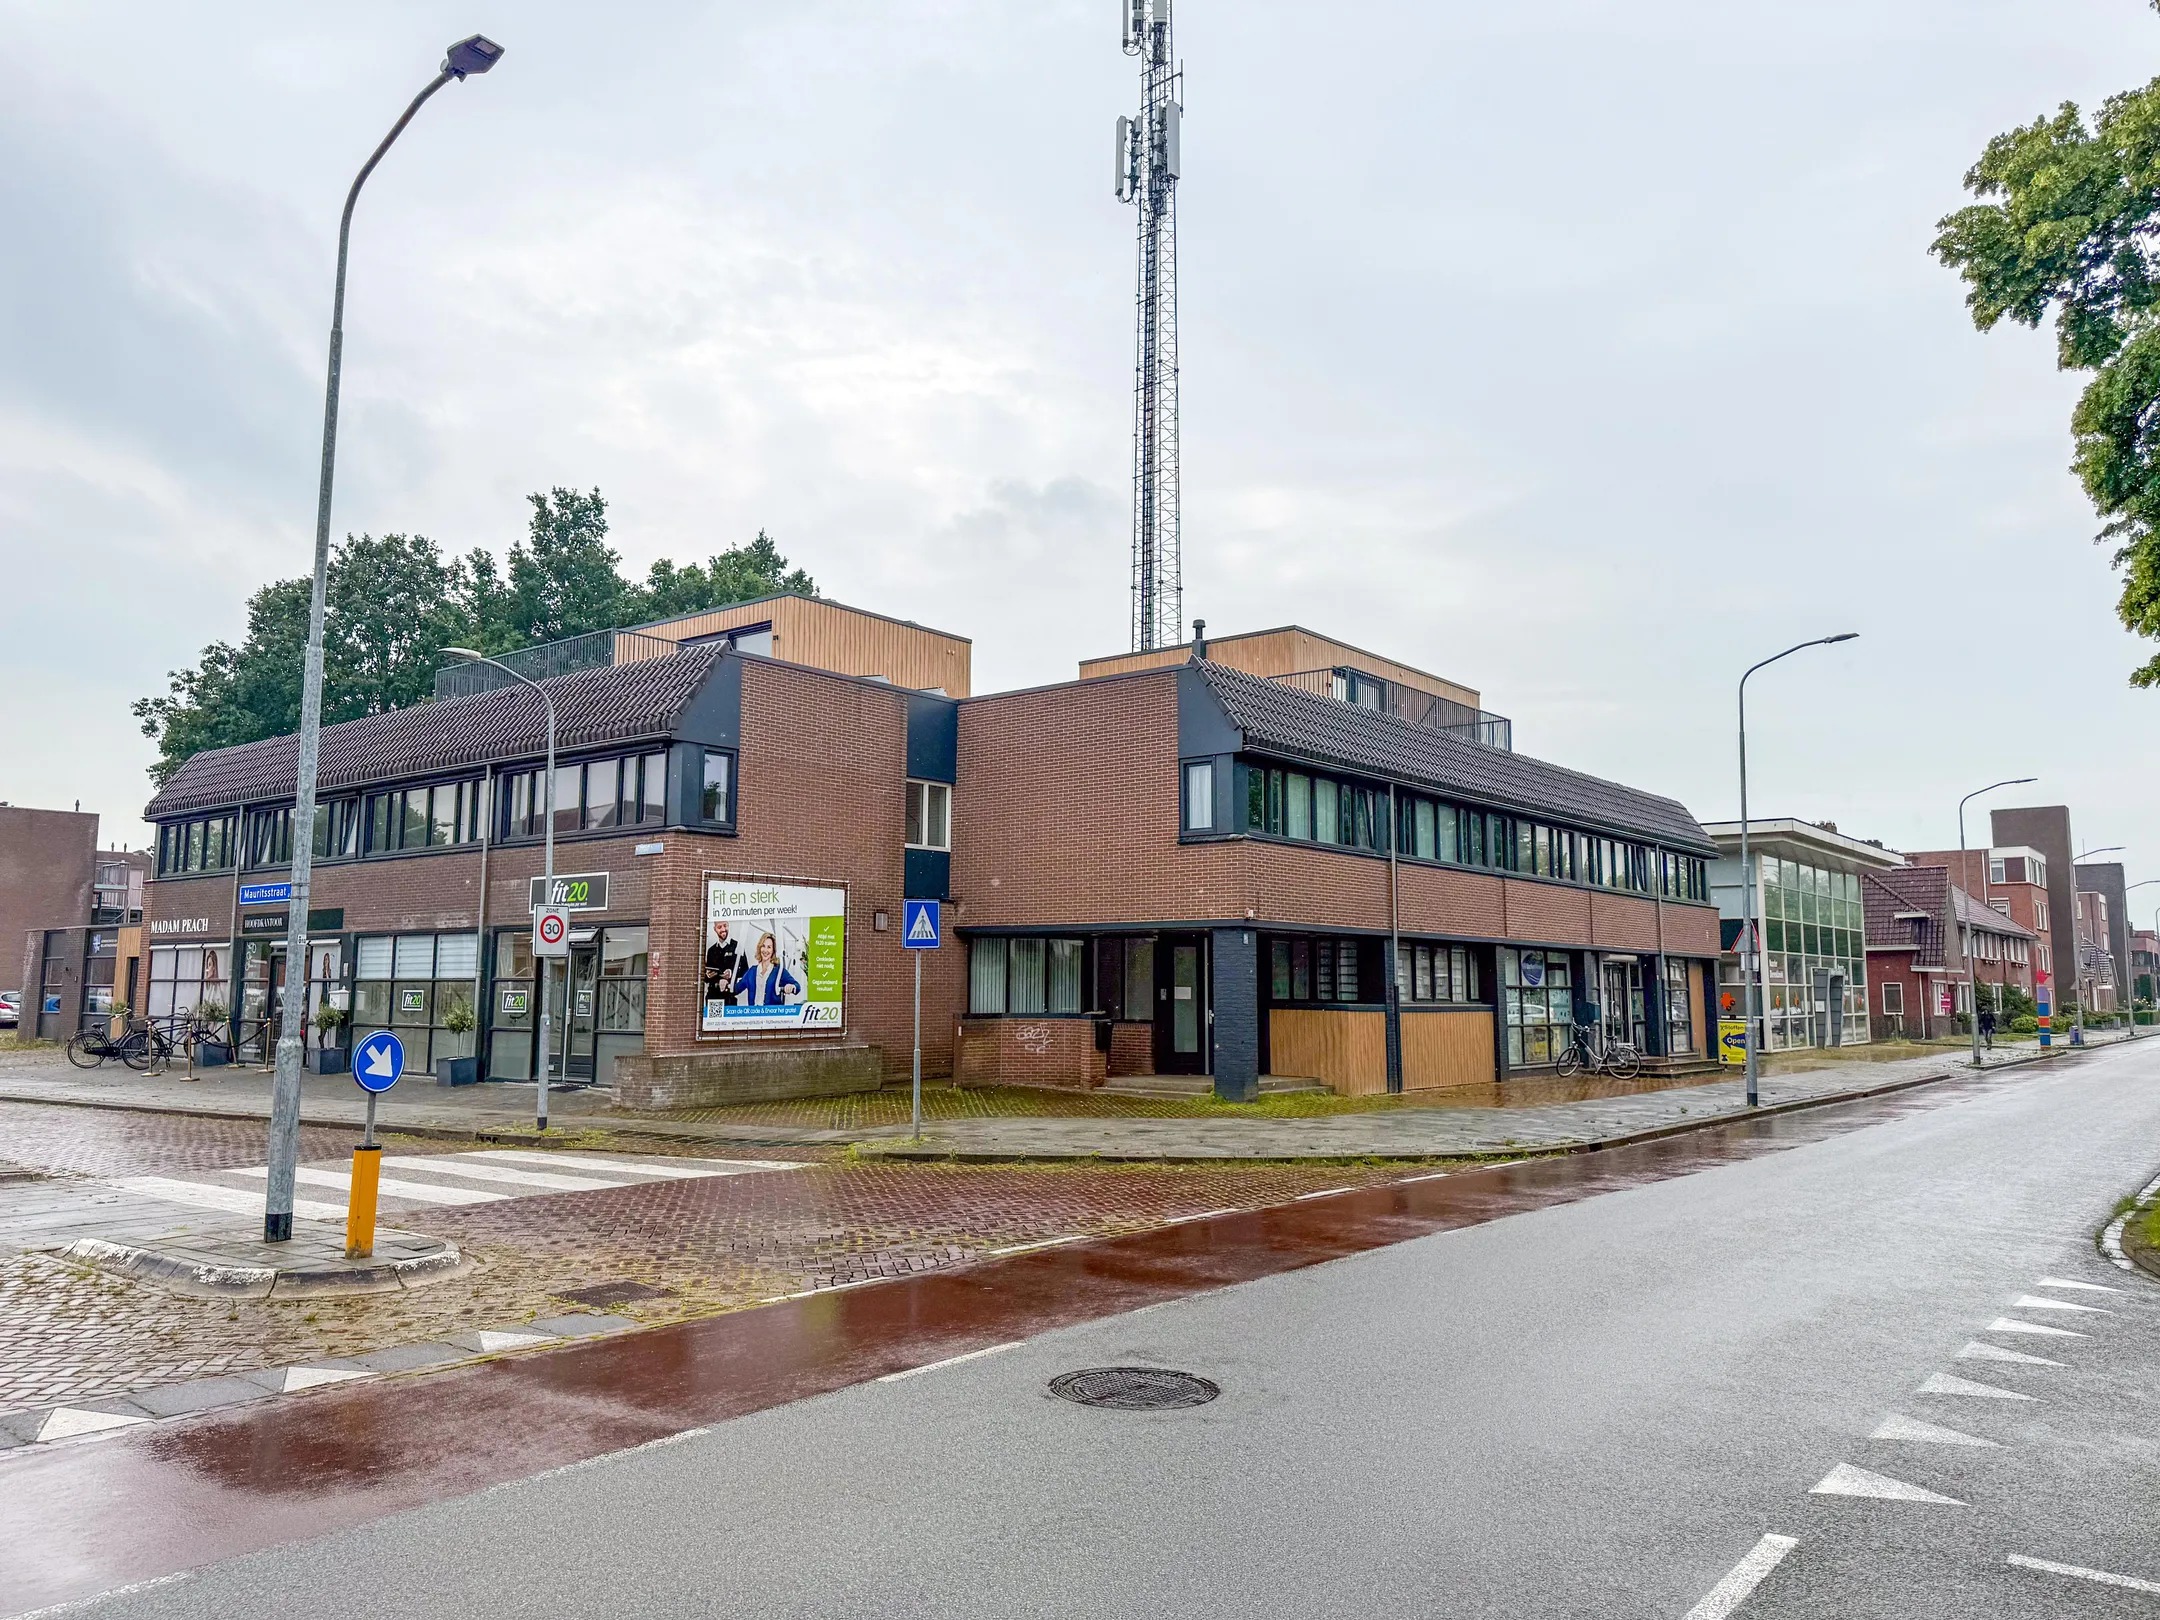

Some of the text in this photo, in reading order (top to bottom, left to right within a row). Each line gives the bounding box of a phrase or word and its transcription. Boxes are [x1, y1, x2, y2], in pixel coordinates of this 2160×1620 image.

[244, 887, 287, 899] Mauritsstraat
[551, 880, 589, 905] fit20
[712, 887, 780, 905] Fit en sterk
[712, 904, 798, 917] in 20 minuten per week!
[150, 917, 209, 934] MADAM PEACH
[244, 916, 283, 929] HOOFDKANTOOR
[544, 923, 560, 935] 30
[404, 993, 421, 1007] fit20
[504, 993, 525, 1009] fit20
[802, 1004, 839, 1024] fit20
[1726, 1037, 1746, 1045] Open
